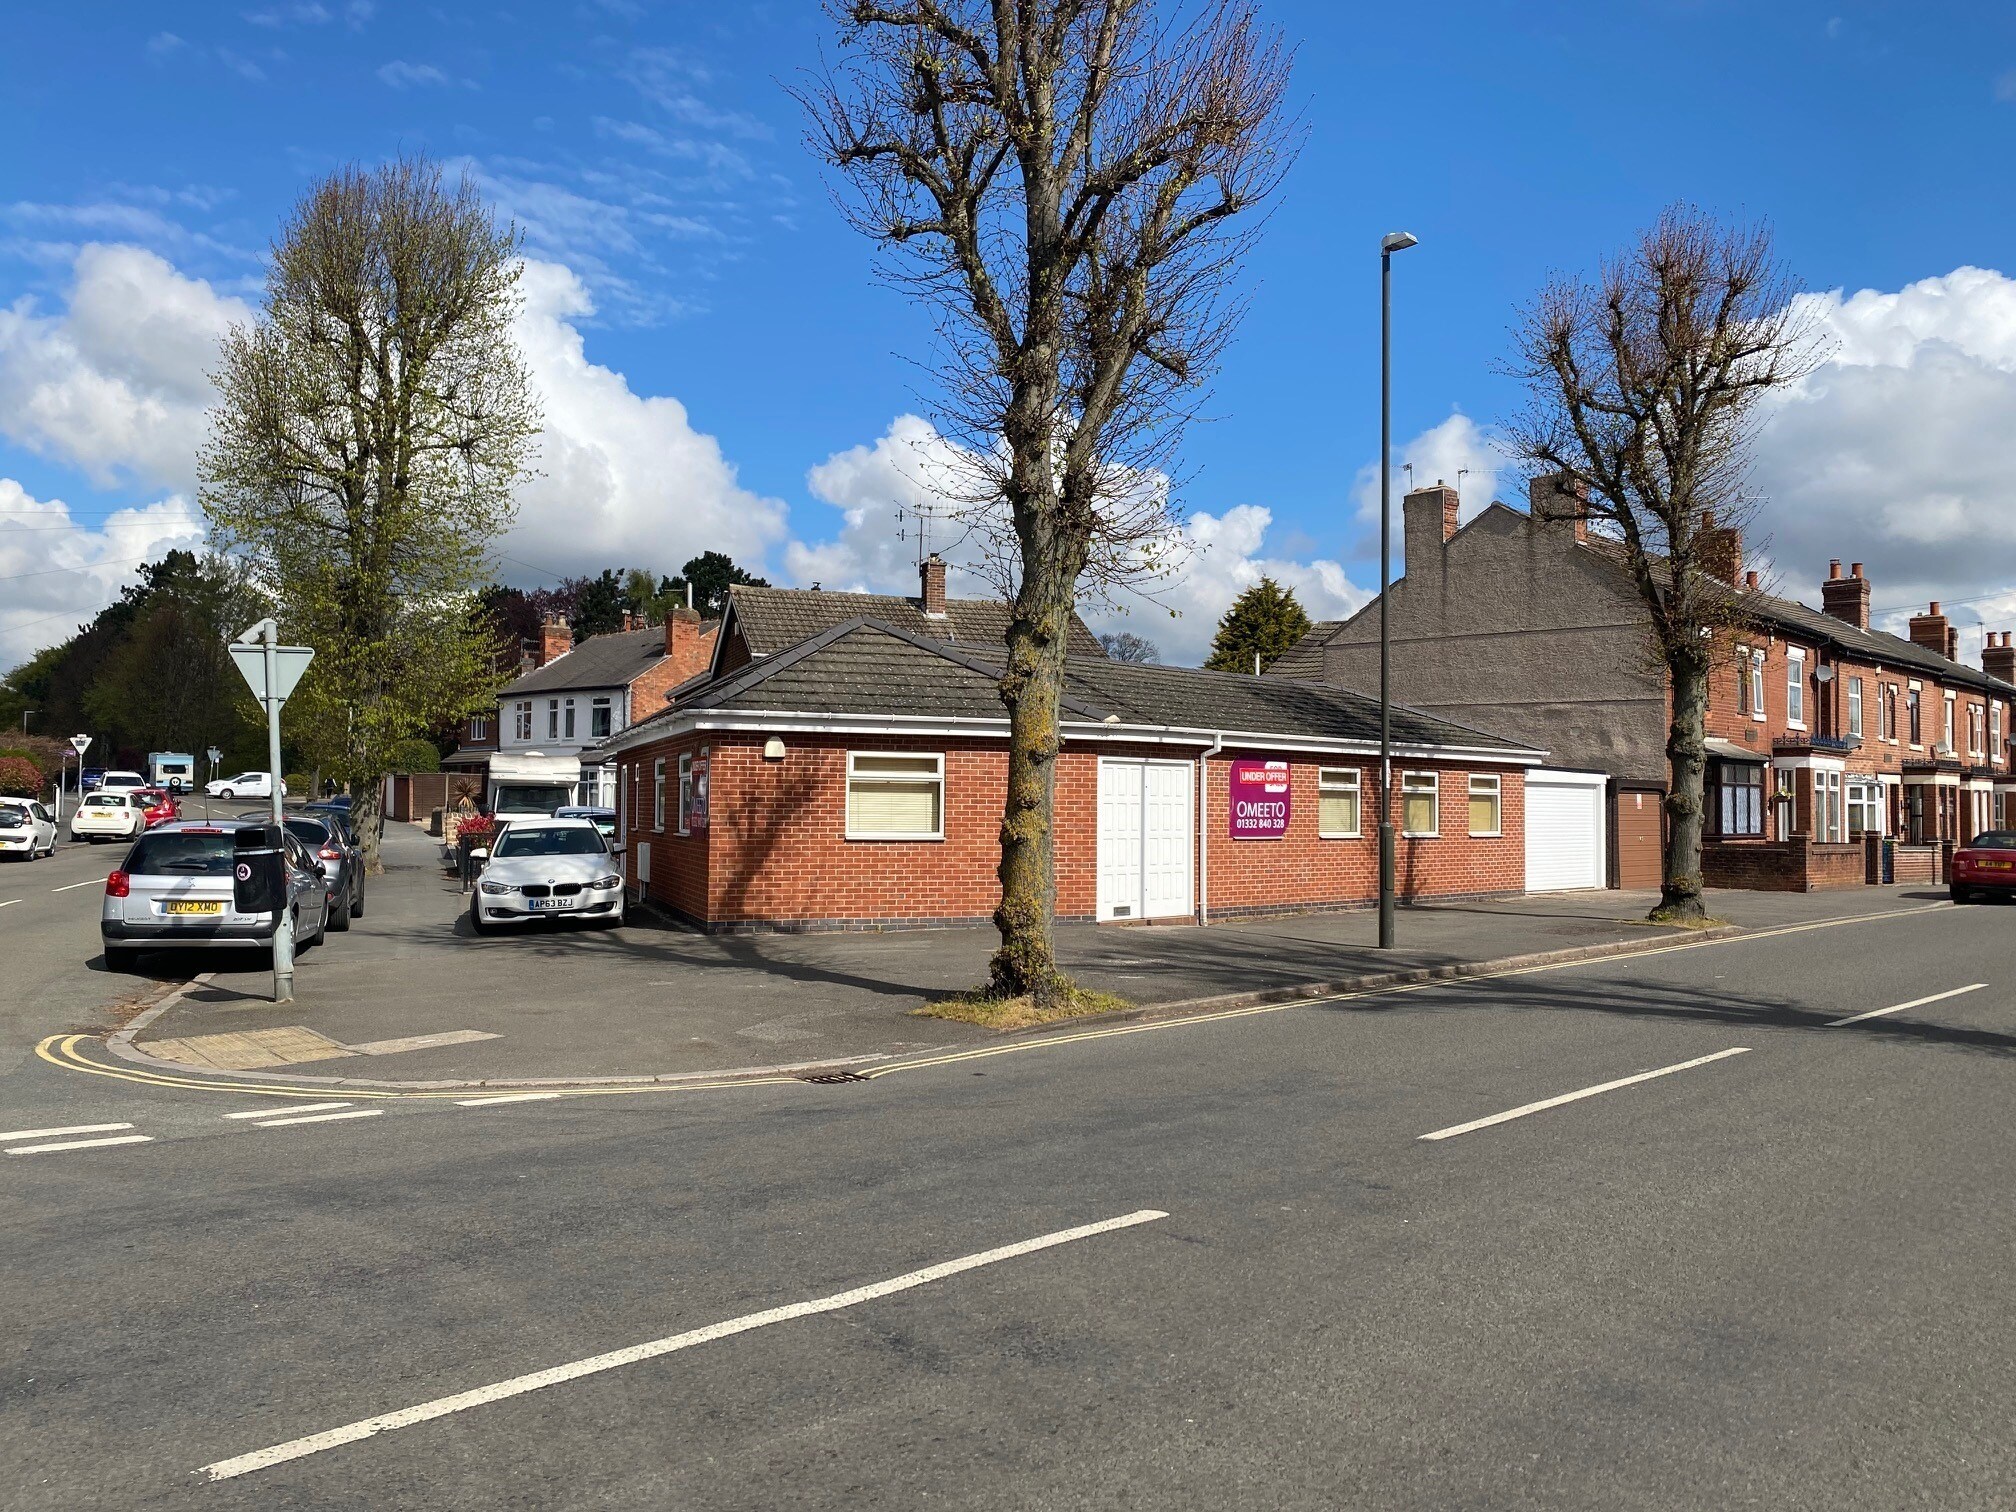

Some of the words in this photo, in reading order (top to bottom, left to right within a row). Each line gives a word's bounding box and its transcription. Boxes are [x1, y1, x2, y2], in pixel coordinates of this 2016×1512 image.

[1241, 771, 1265, 782] UNDER
[1265, 771, 1287, 782] OFFER
[1236, 800, 1286, 818] OMEETO
[1236, 818, 1258, 829] 01332
[1258, 818, 1272, 829] 840
[1272, 818, 1285, 829] 328
[535, 900, 556, 908] AP63
[557, 899, 573, 907] BZJ
